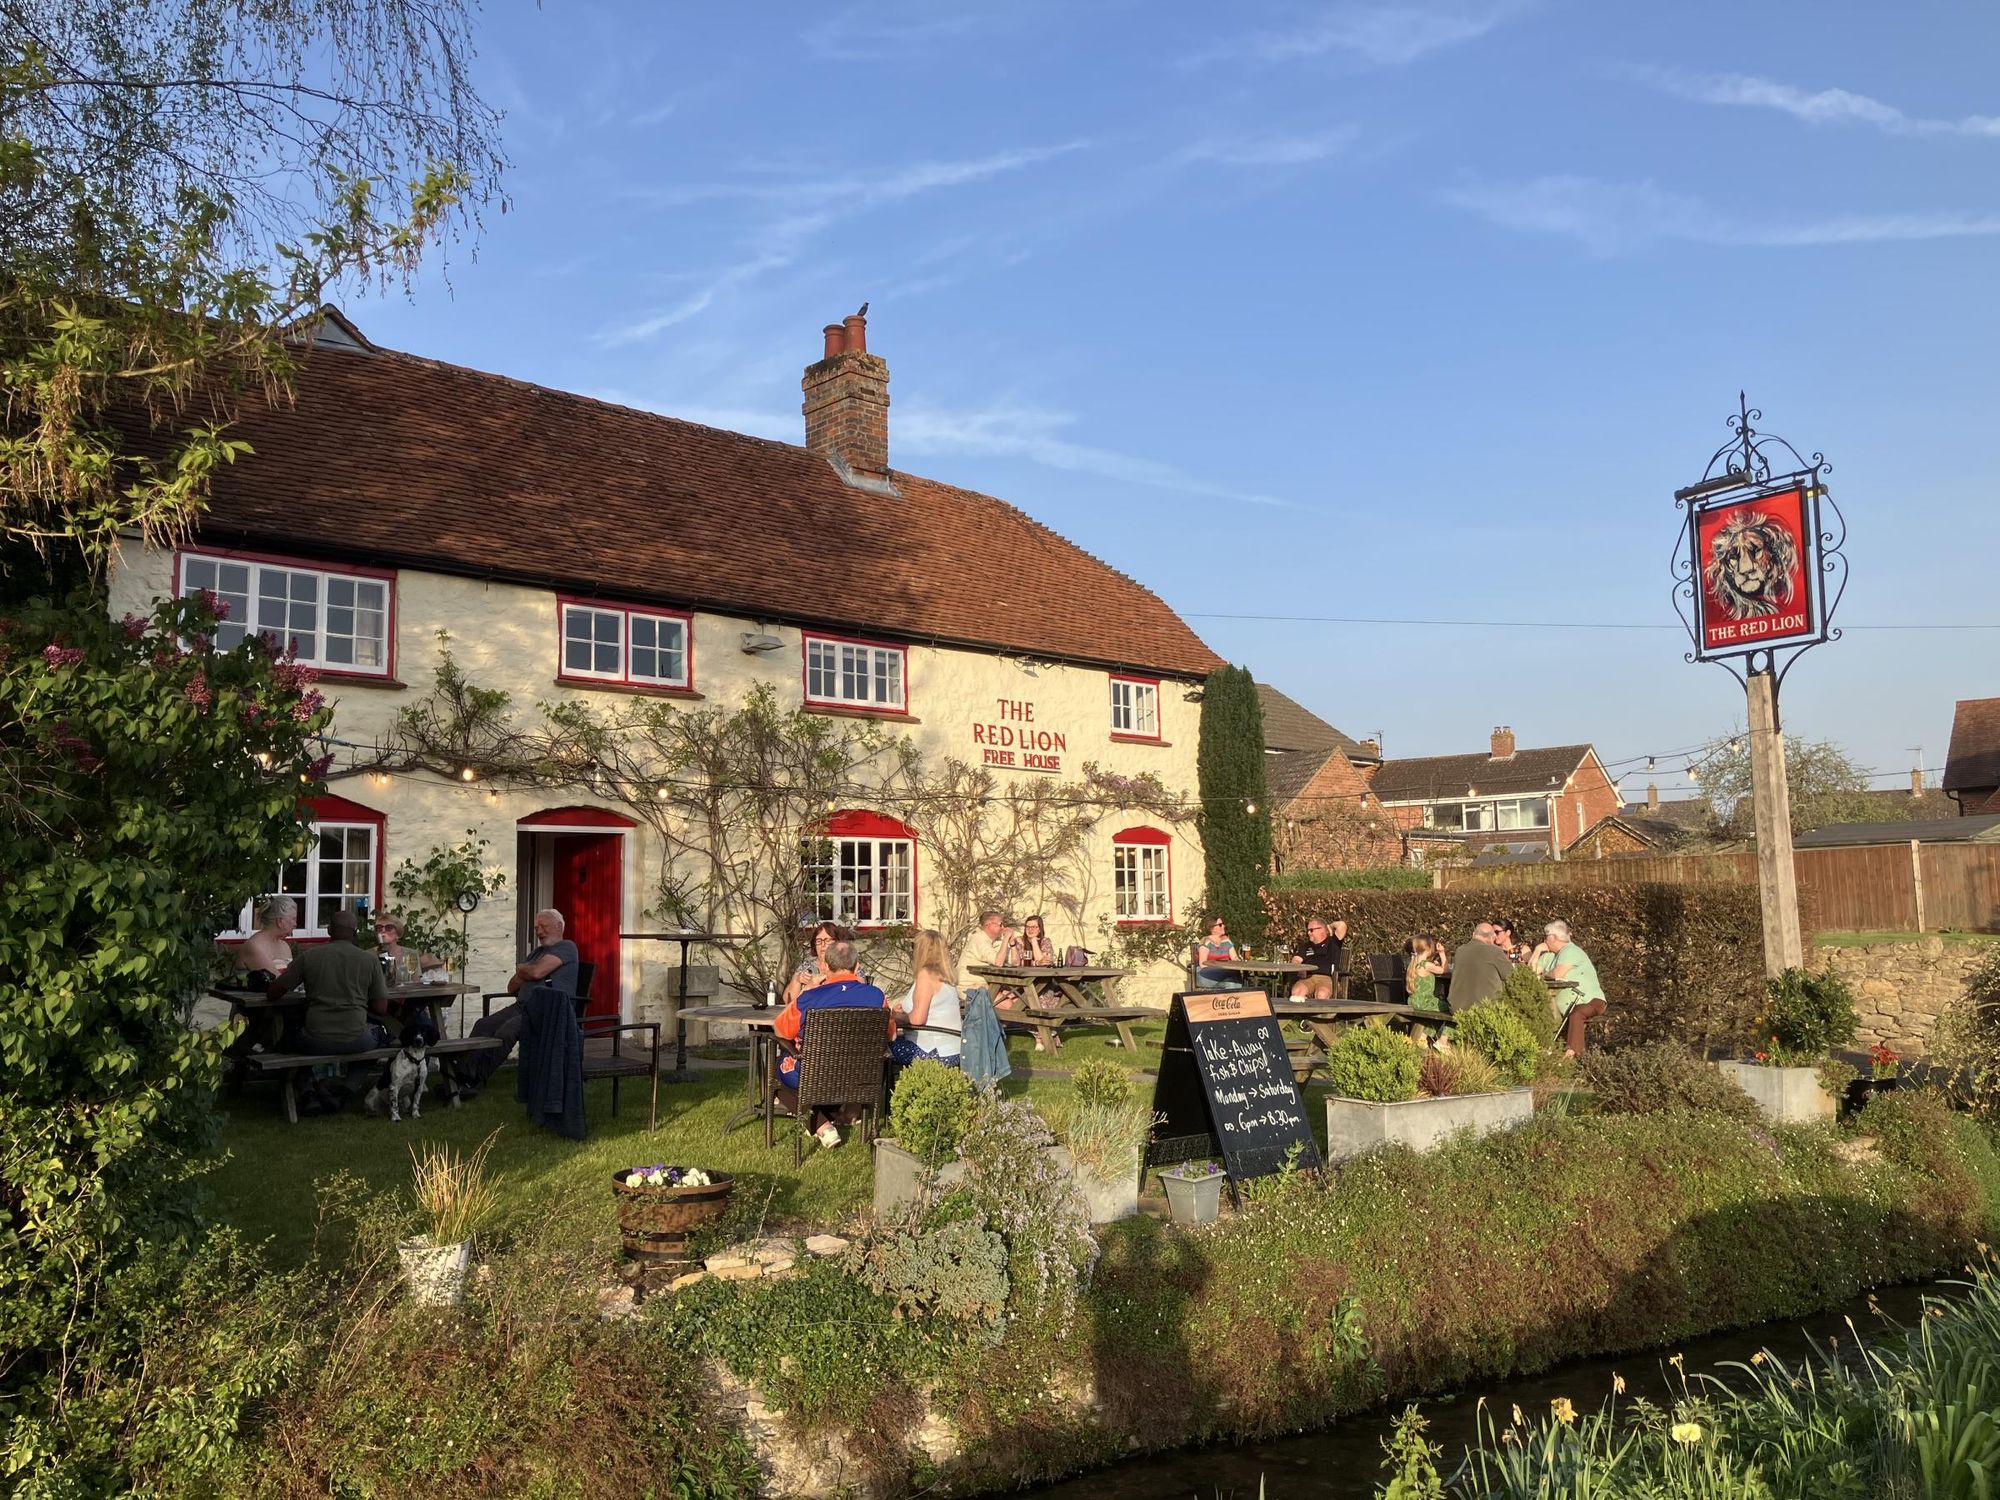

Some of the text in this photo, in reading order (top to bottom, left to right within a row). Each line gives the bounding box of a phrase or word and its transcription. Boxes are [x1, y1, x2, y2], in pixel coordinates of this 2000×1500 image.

[1709, 614, 1804, 641] THE RED LION
[997, 698, 1034, 722] THE
[973, 723, 1066, 752] RED LION
[983, 749, 1060, 770] FREE HOUSE
[1215, 1078, 1296, 1110] Monday Saturday
[1238, 1112, 1259, 1133] 6pm
